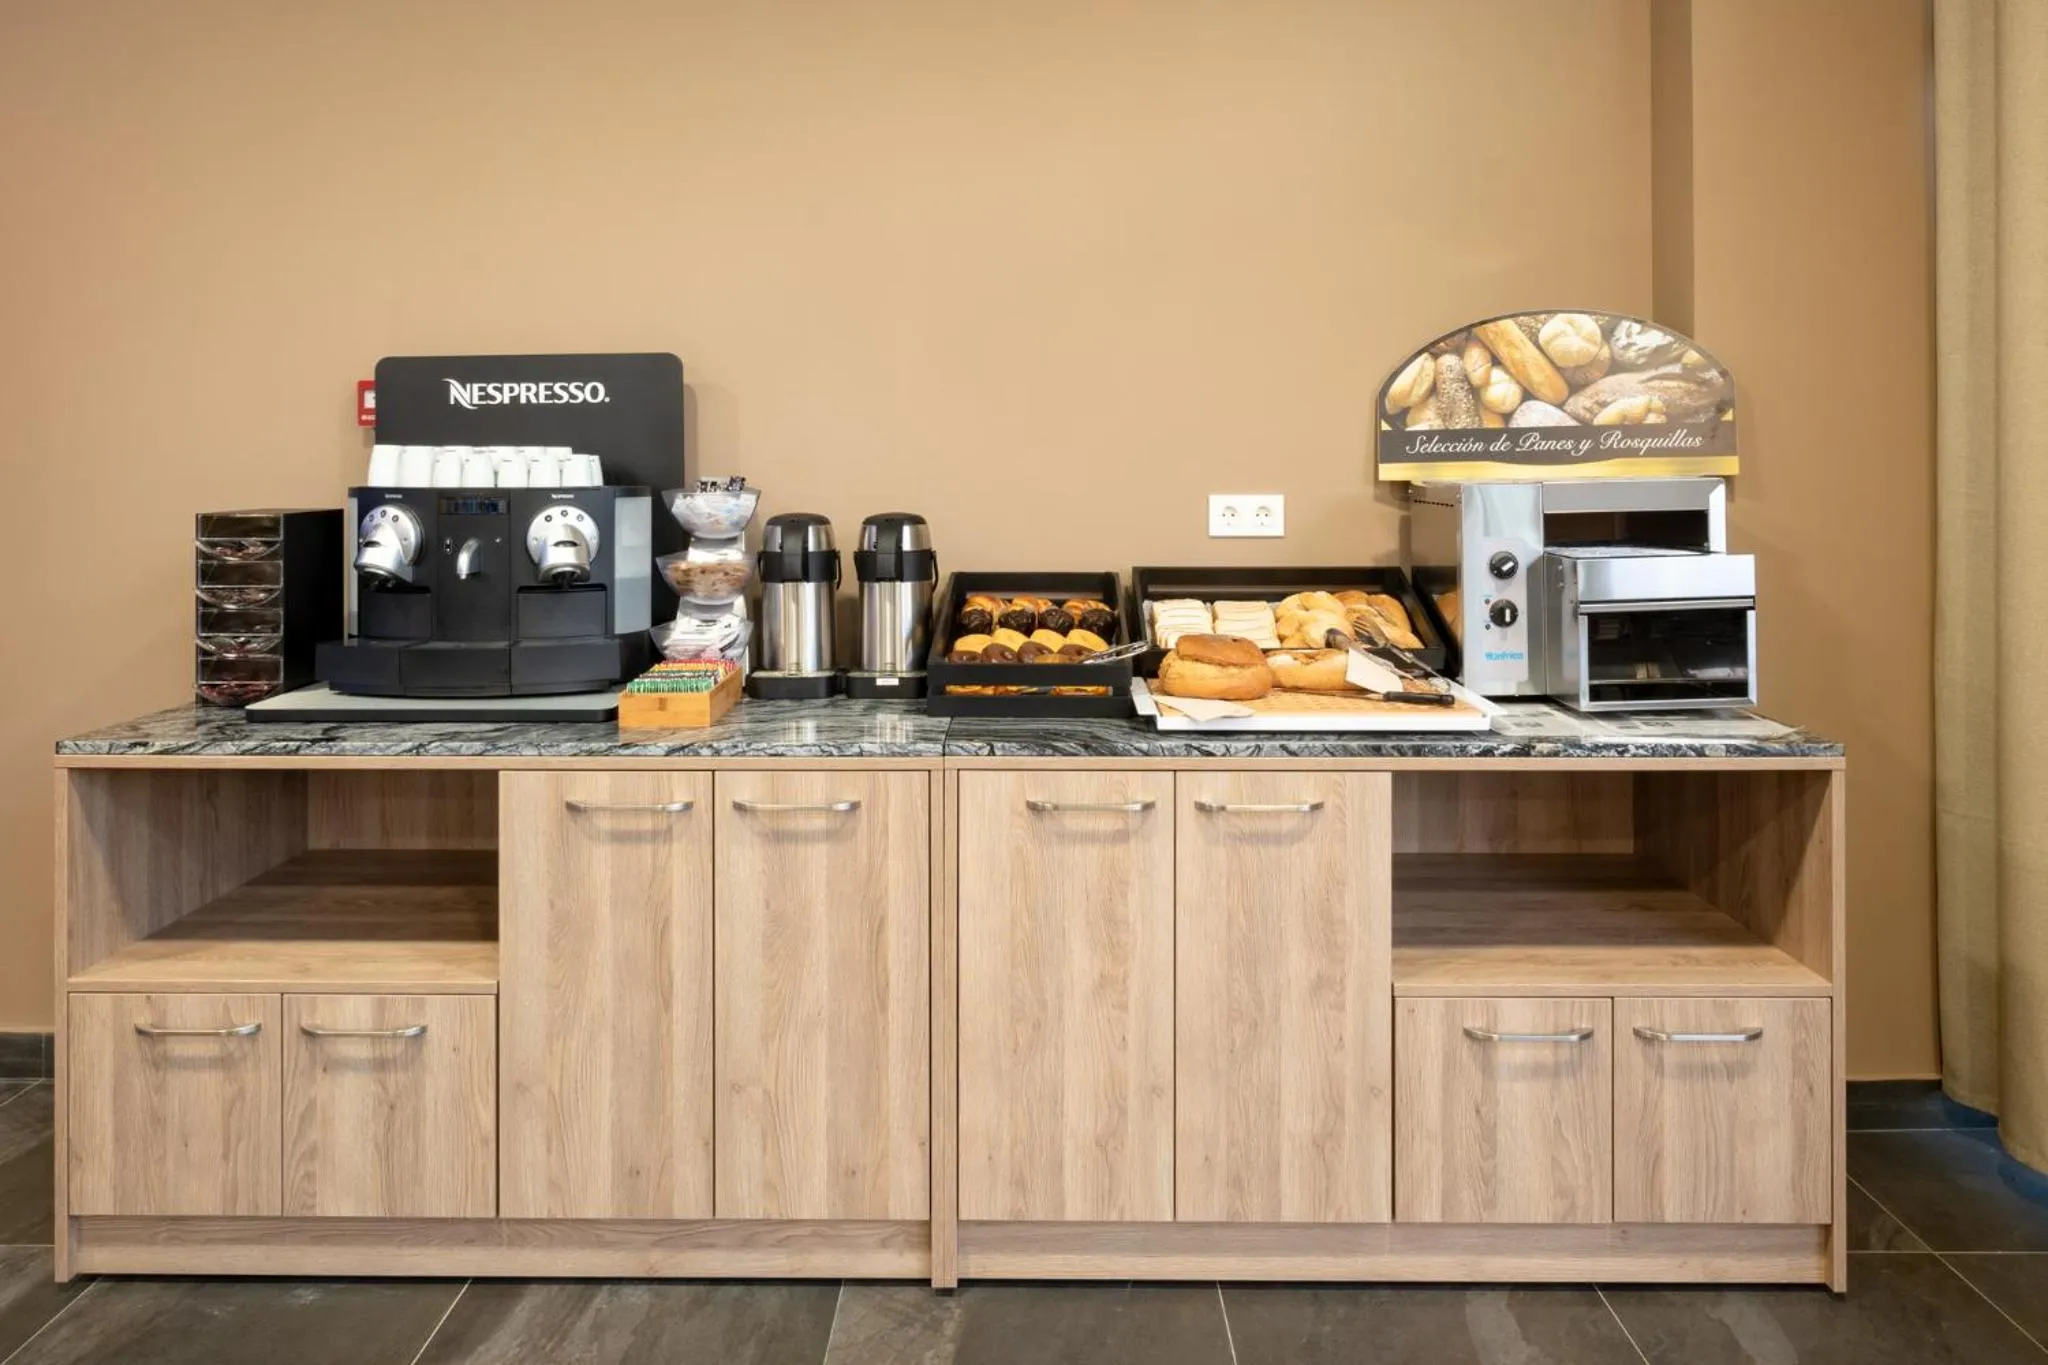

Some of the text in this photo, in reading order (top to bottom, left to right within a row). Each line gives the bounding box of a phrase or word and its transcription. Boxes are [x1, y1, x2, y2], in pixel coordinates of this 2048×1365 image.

[1405, 429, 1703, 457] Selección de Panes y Rosquillas
